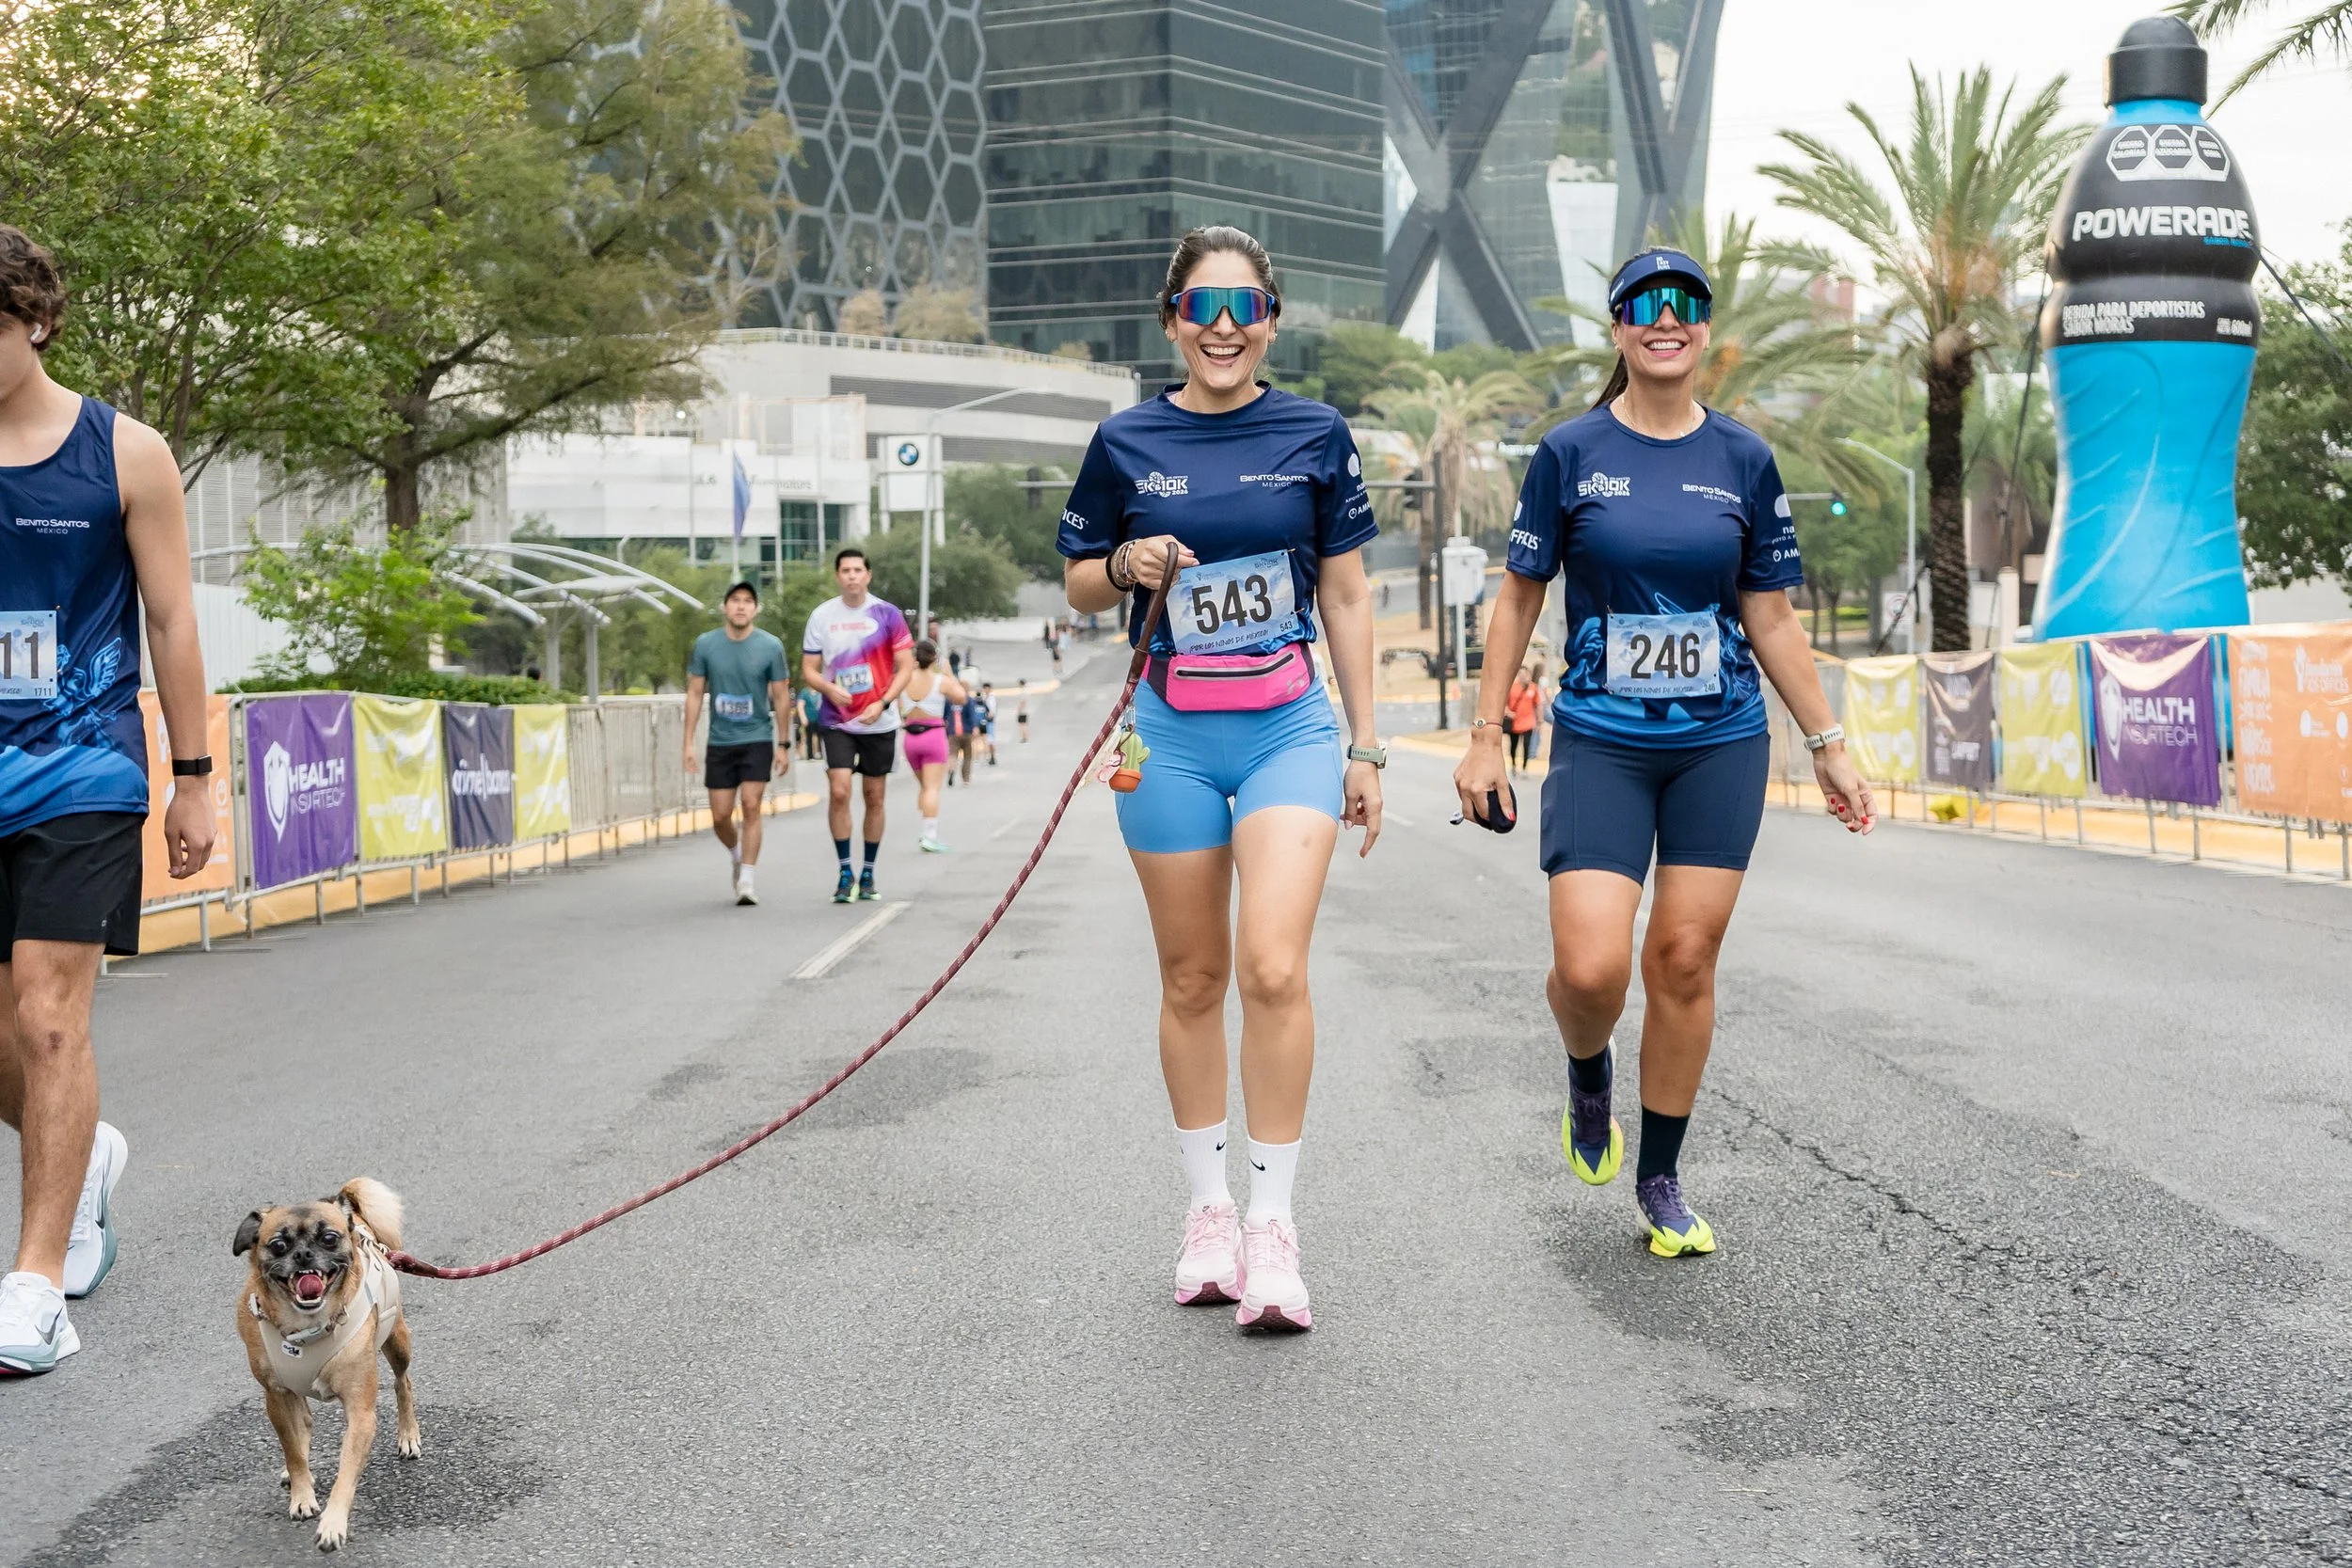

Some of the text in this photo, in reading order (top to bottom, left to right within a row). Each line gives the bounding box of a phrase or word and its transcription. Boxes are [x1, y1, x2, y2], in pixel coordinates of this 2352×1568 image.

[2072, 206, 2254, 242] POWERADE
[2097, 302, 2128, 318] PARA
[2129, 300, 2205, 319] DEPORTISTAS
[1239, 473, 1309, 483] BENITO SANTOS
[1682, 483, 1741, 504] BENITO SANTOS
[15, 517, 90, 529] BENITO SANTOS
[1062, 508, 1084, 530] ICES
[1191, 575, 1273, 635] 543
[1279, 620, 1293, 632] 543
[1630, 632, 1700, 679] 246
[34, 688, 52, 696] 1711
[2122, 697, 2196, 725] HEALTH
[288, 757, 346, 792] HEALTH
